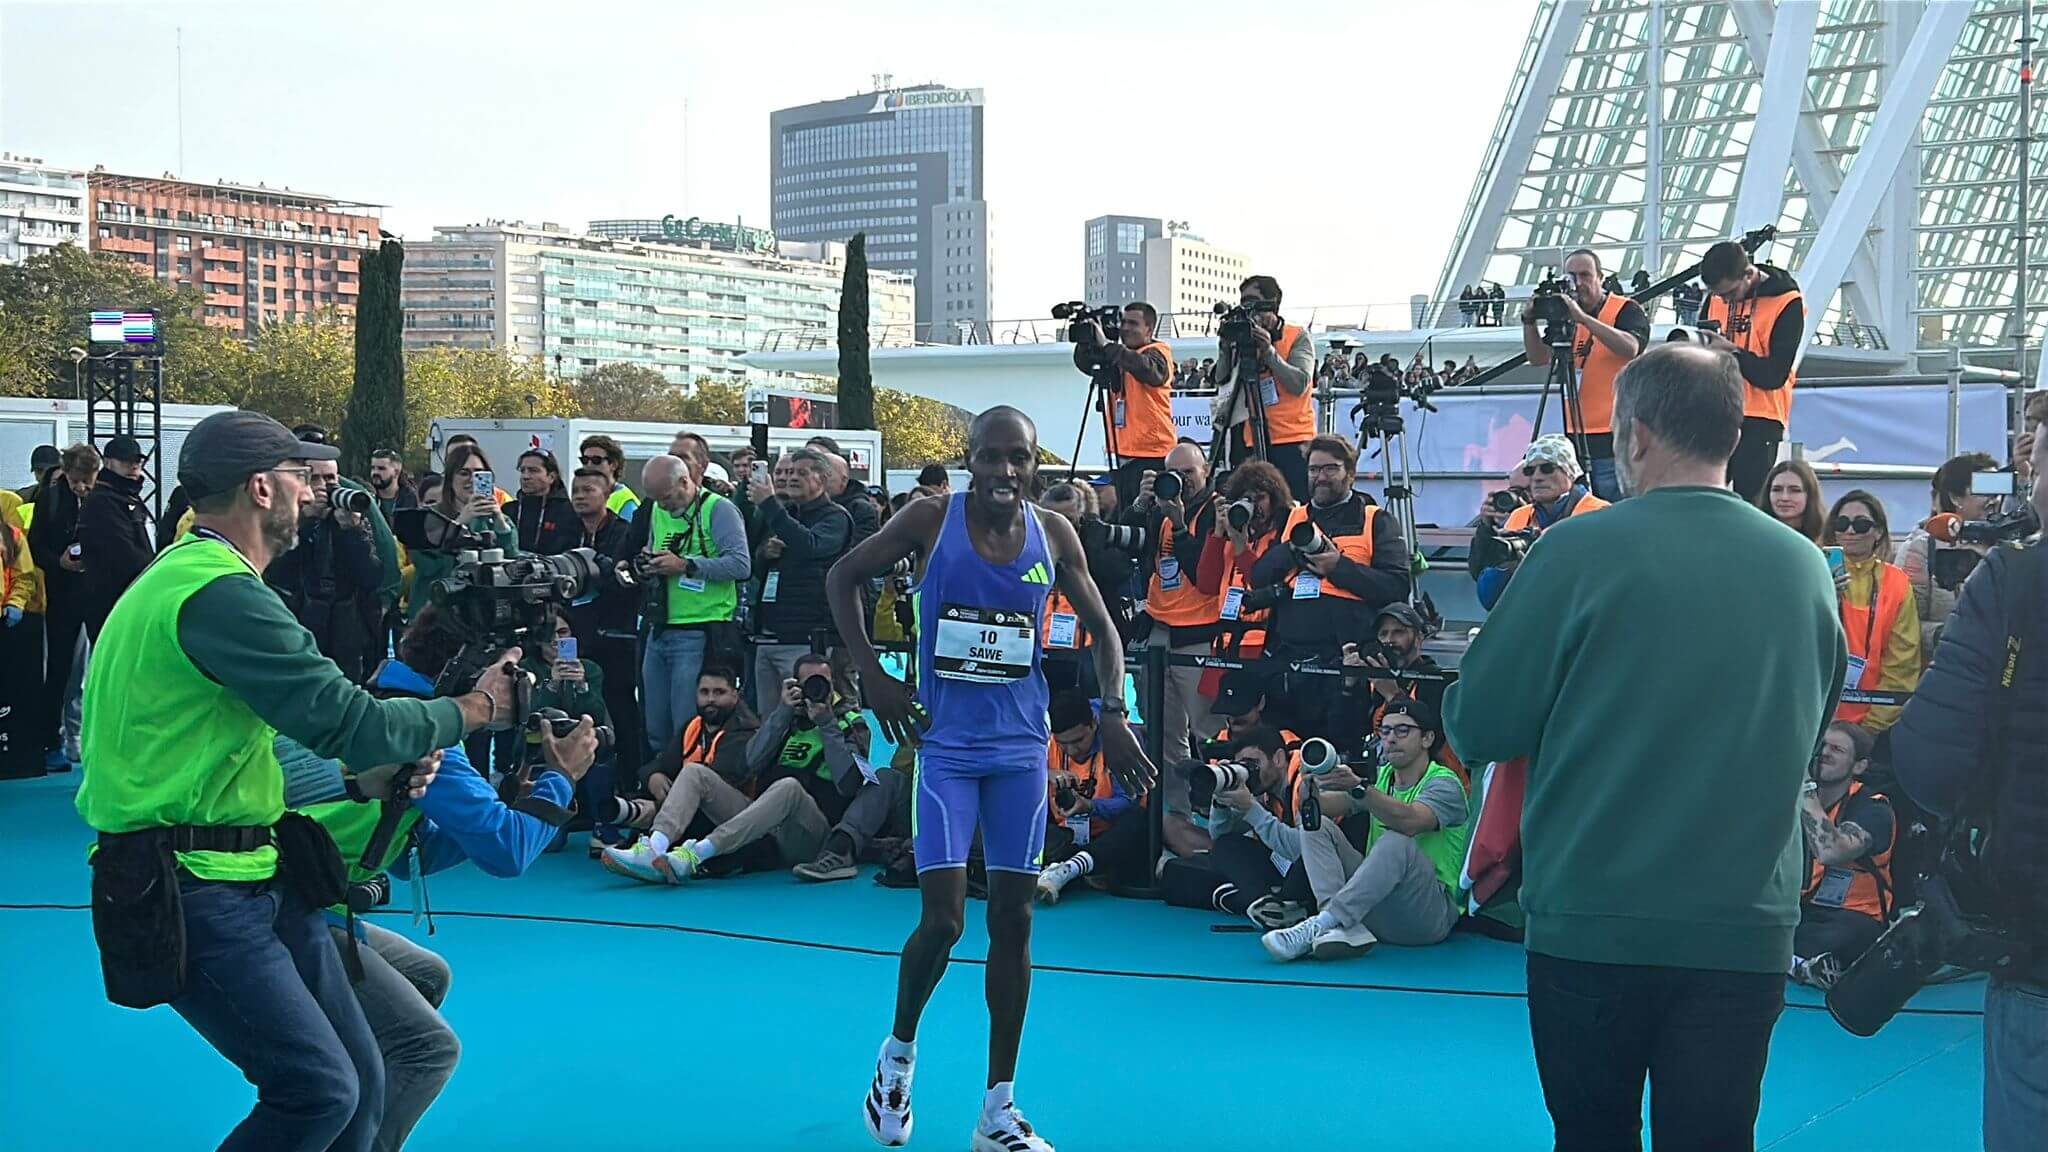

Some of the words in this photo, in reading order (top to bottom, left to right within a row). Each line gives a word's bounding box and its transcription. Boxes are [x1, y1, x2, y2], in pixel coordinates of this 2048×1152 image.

[904, 91, 973, 106] IBERDROLA
[979, 630, 998, 645] 10
[969, 646, 1003, 661] SAWE
[2000, 653, 2017, 688] Nikon
